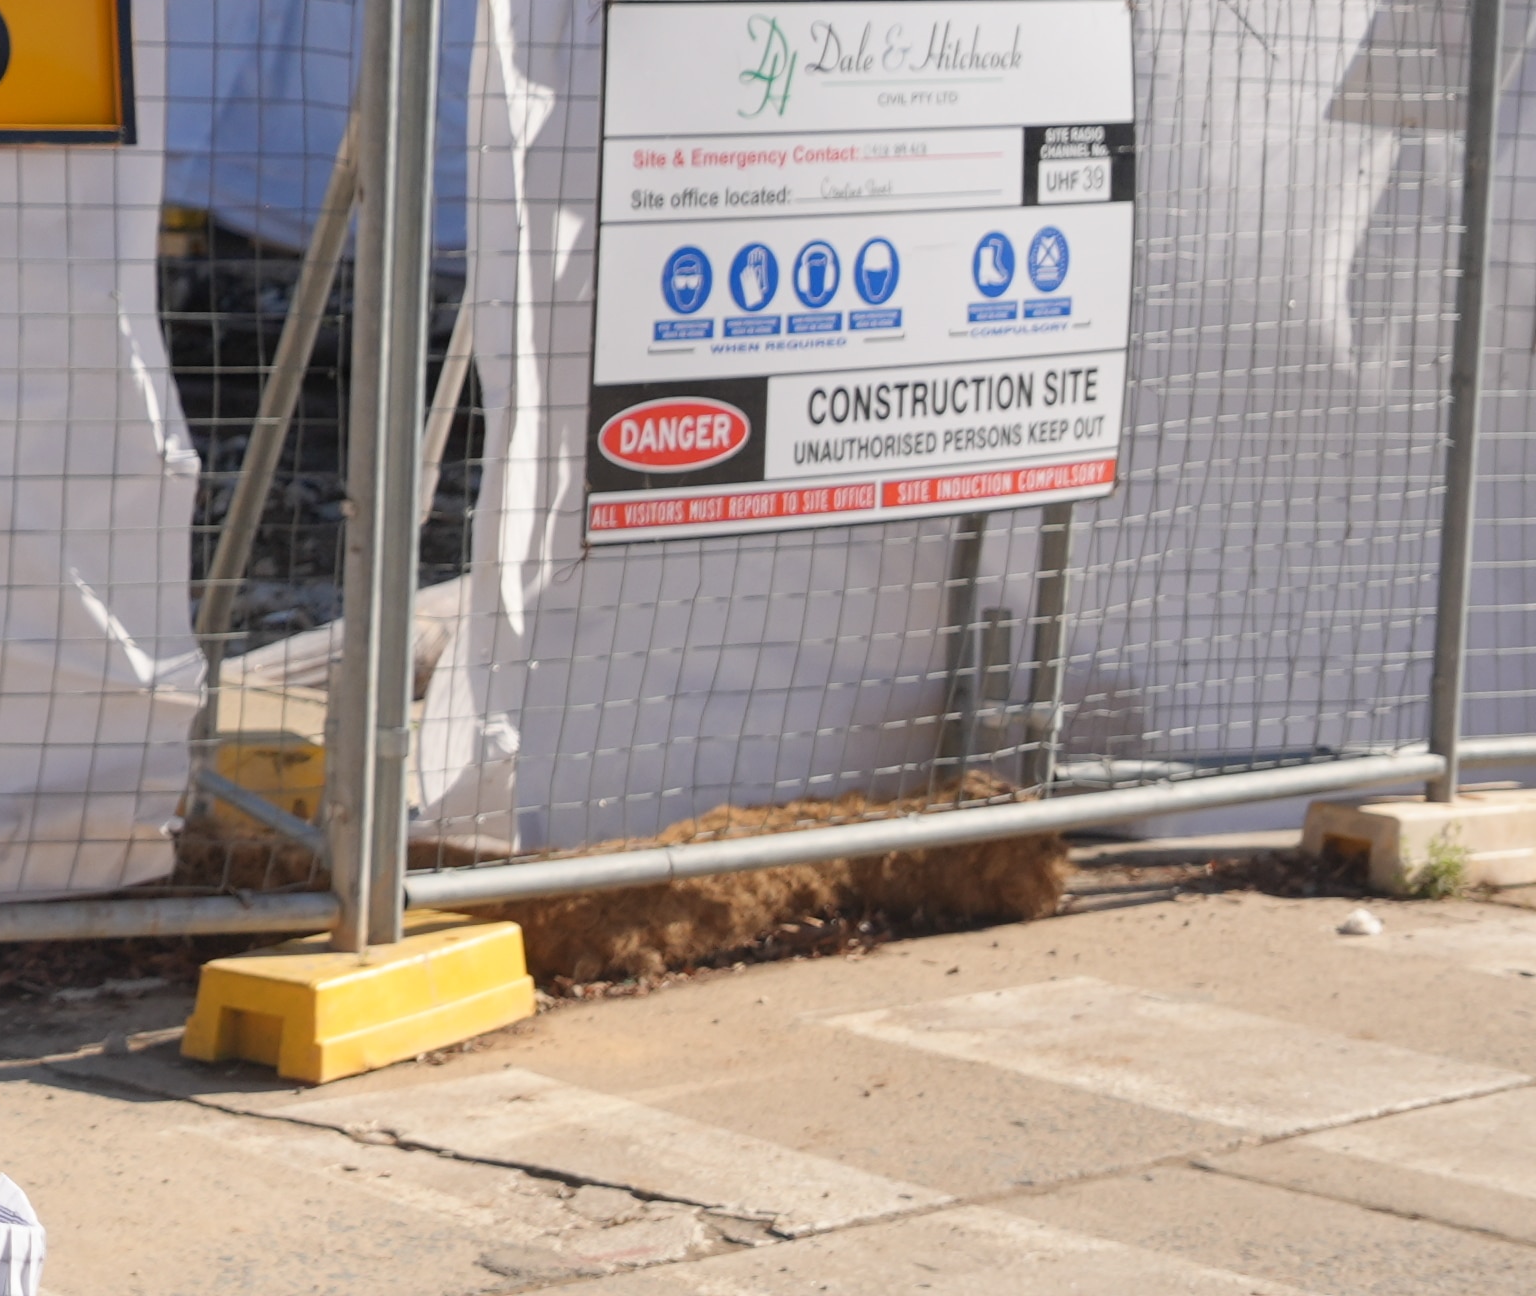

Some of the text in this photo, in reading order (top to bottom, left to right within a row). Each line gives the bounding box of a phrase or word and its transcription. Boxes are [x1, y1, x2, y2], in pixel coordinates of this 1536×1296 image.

[805, 18, 1023, 74] Dale & Hitchcock
[632, 148, 667, 170] Site
[672, 149, 685, 167] &
[690, 147, 788, 171] Emergency
[792, 143, 860, 164] Contact:
[630, 184, 792, 211] Site office located:
[1046, 169, 1079, 192] UHF
[807, 366, 1099, 426] CONSTRUCTION SITE
[619, 413, 732, 454] DANGER
[793, 415, 1105, 466] UNAUTHORISED PERSONS KEEP OUT
[897, 462, 1107, 504] SITE INDUCTION COMPULSORY
[590, 484, 875, 529] ALL VISITORS MUST REPORT TO SITE OFFICE
